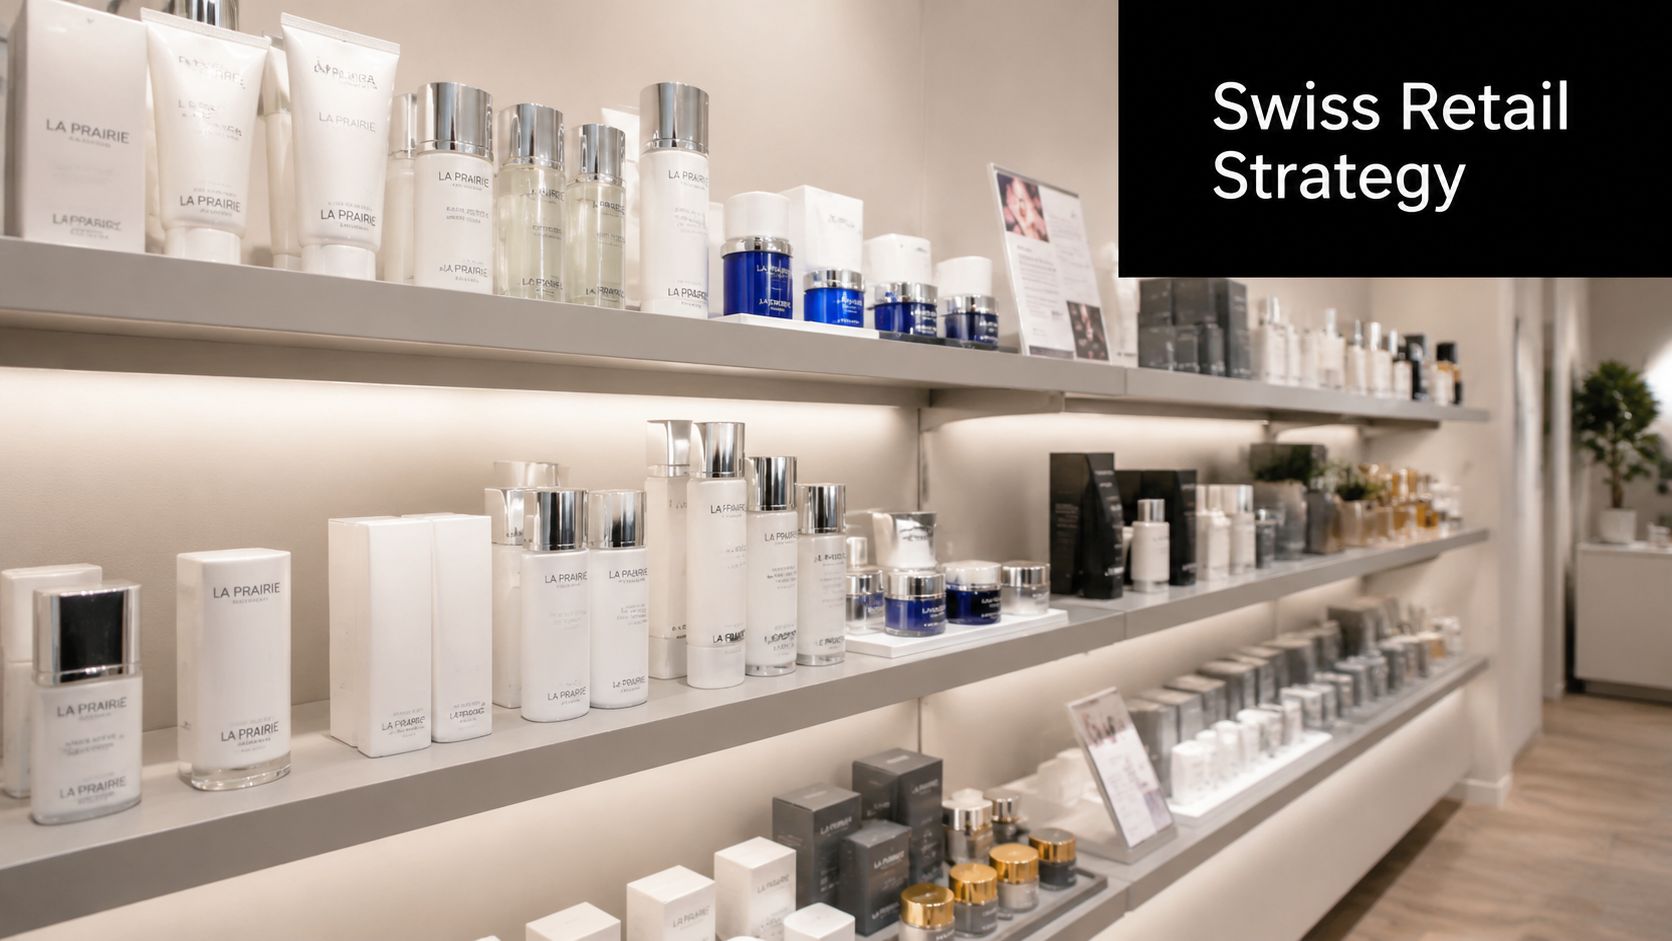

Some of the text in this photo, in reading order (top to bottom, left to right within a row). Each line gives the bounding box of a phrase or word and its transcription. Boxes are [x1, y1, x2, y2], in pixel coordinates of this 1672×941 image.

[46, 118, 67, 133] LA
[71, 122, 130, 144] PRAIRIE
[438, 171, 452, 182] LA
[668, 169, 680, 180] LA
[179, 195, 241, 213] LA PRAIRIE
[320, 209, 377, 227] LA PRAIRIE
[667, 287, 680, 297] LA
[710, 504, 722, 514] LA
[764, 533, 775, 542] LA
[544, 575, 557, 584] LA
[608, 570, 621, 580] LA
[212, 581, 281, 599] LA PRAIRIE
[547, 692, 558, 701] LA
[57, 696, 128, 718] LA PRAIRIE
[220, 720, 280, 743] LA PRAIRIE
[60, 786, 76, 800] LA
